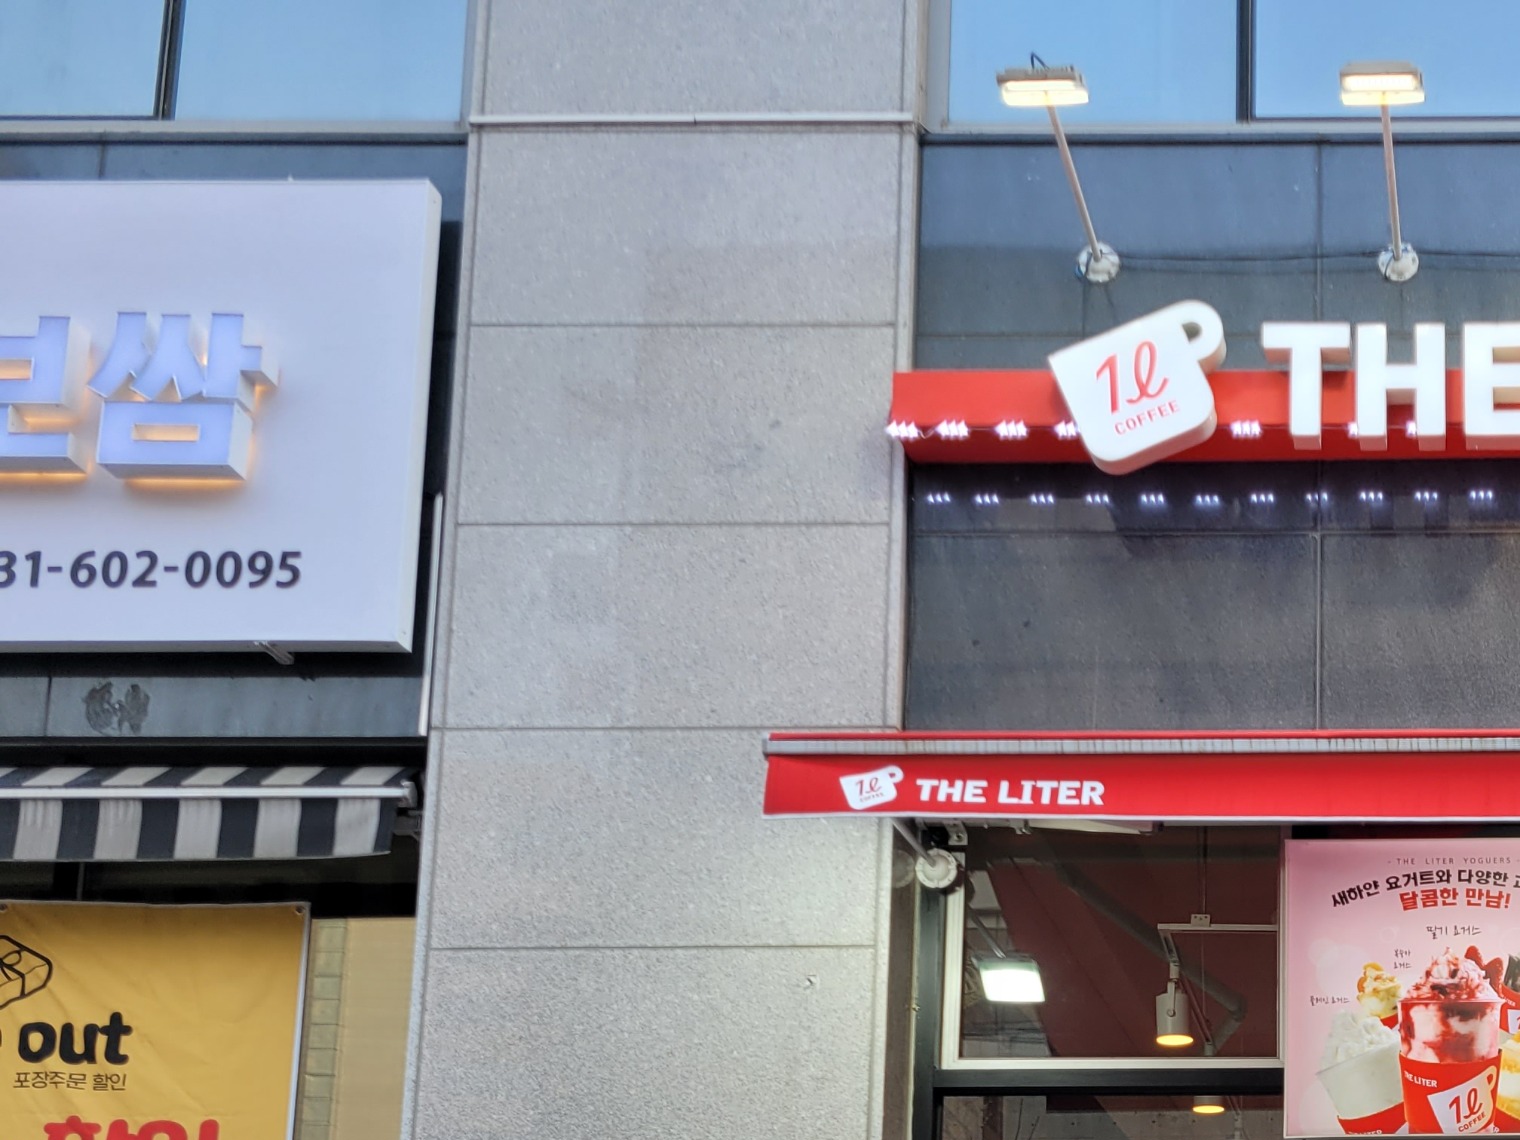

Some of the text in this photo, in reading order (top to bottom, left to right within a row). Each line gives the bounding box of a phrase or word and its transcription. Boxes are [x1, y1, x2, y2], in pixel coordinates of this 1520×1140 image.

[1113, 399, 1181, 436] COFFEE
[916, 778, 1105, 805] THE LITER
[1396, 857, 1416, 865] THE
[1331, 880, 1380, 907] 새하얀
[1385, 869, 1453, 891] 요거트와
[1457, 869, 1509, 887] 다양한
[1399, 887, 1511, 912] 달콤한 만남!
[1426, 925, 1448, 940] 딸기
[17, 1011, 134, 1066] out
[13, 1070, 128, 1092] 포장주문 할인
[1414, 1075, 1438, 1088] LITER
[1458, 1112, 1486, 1133] COFFEE
